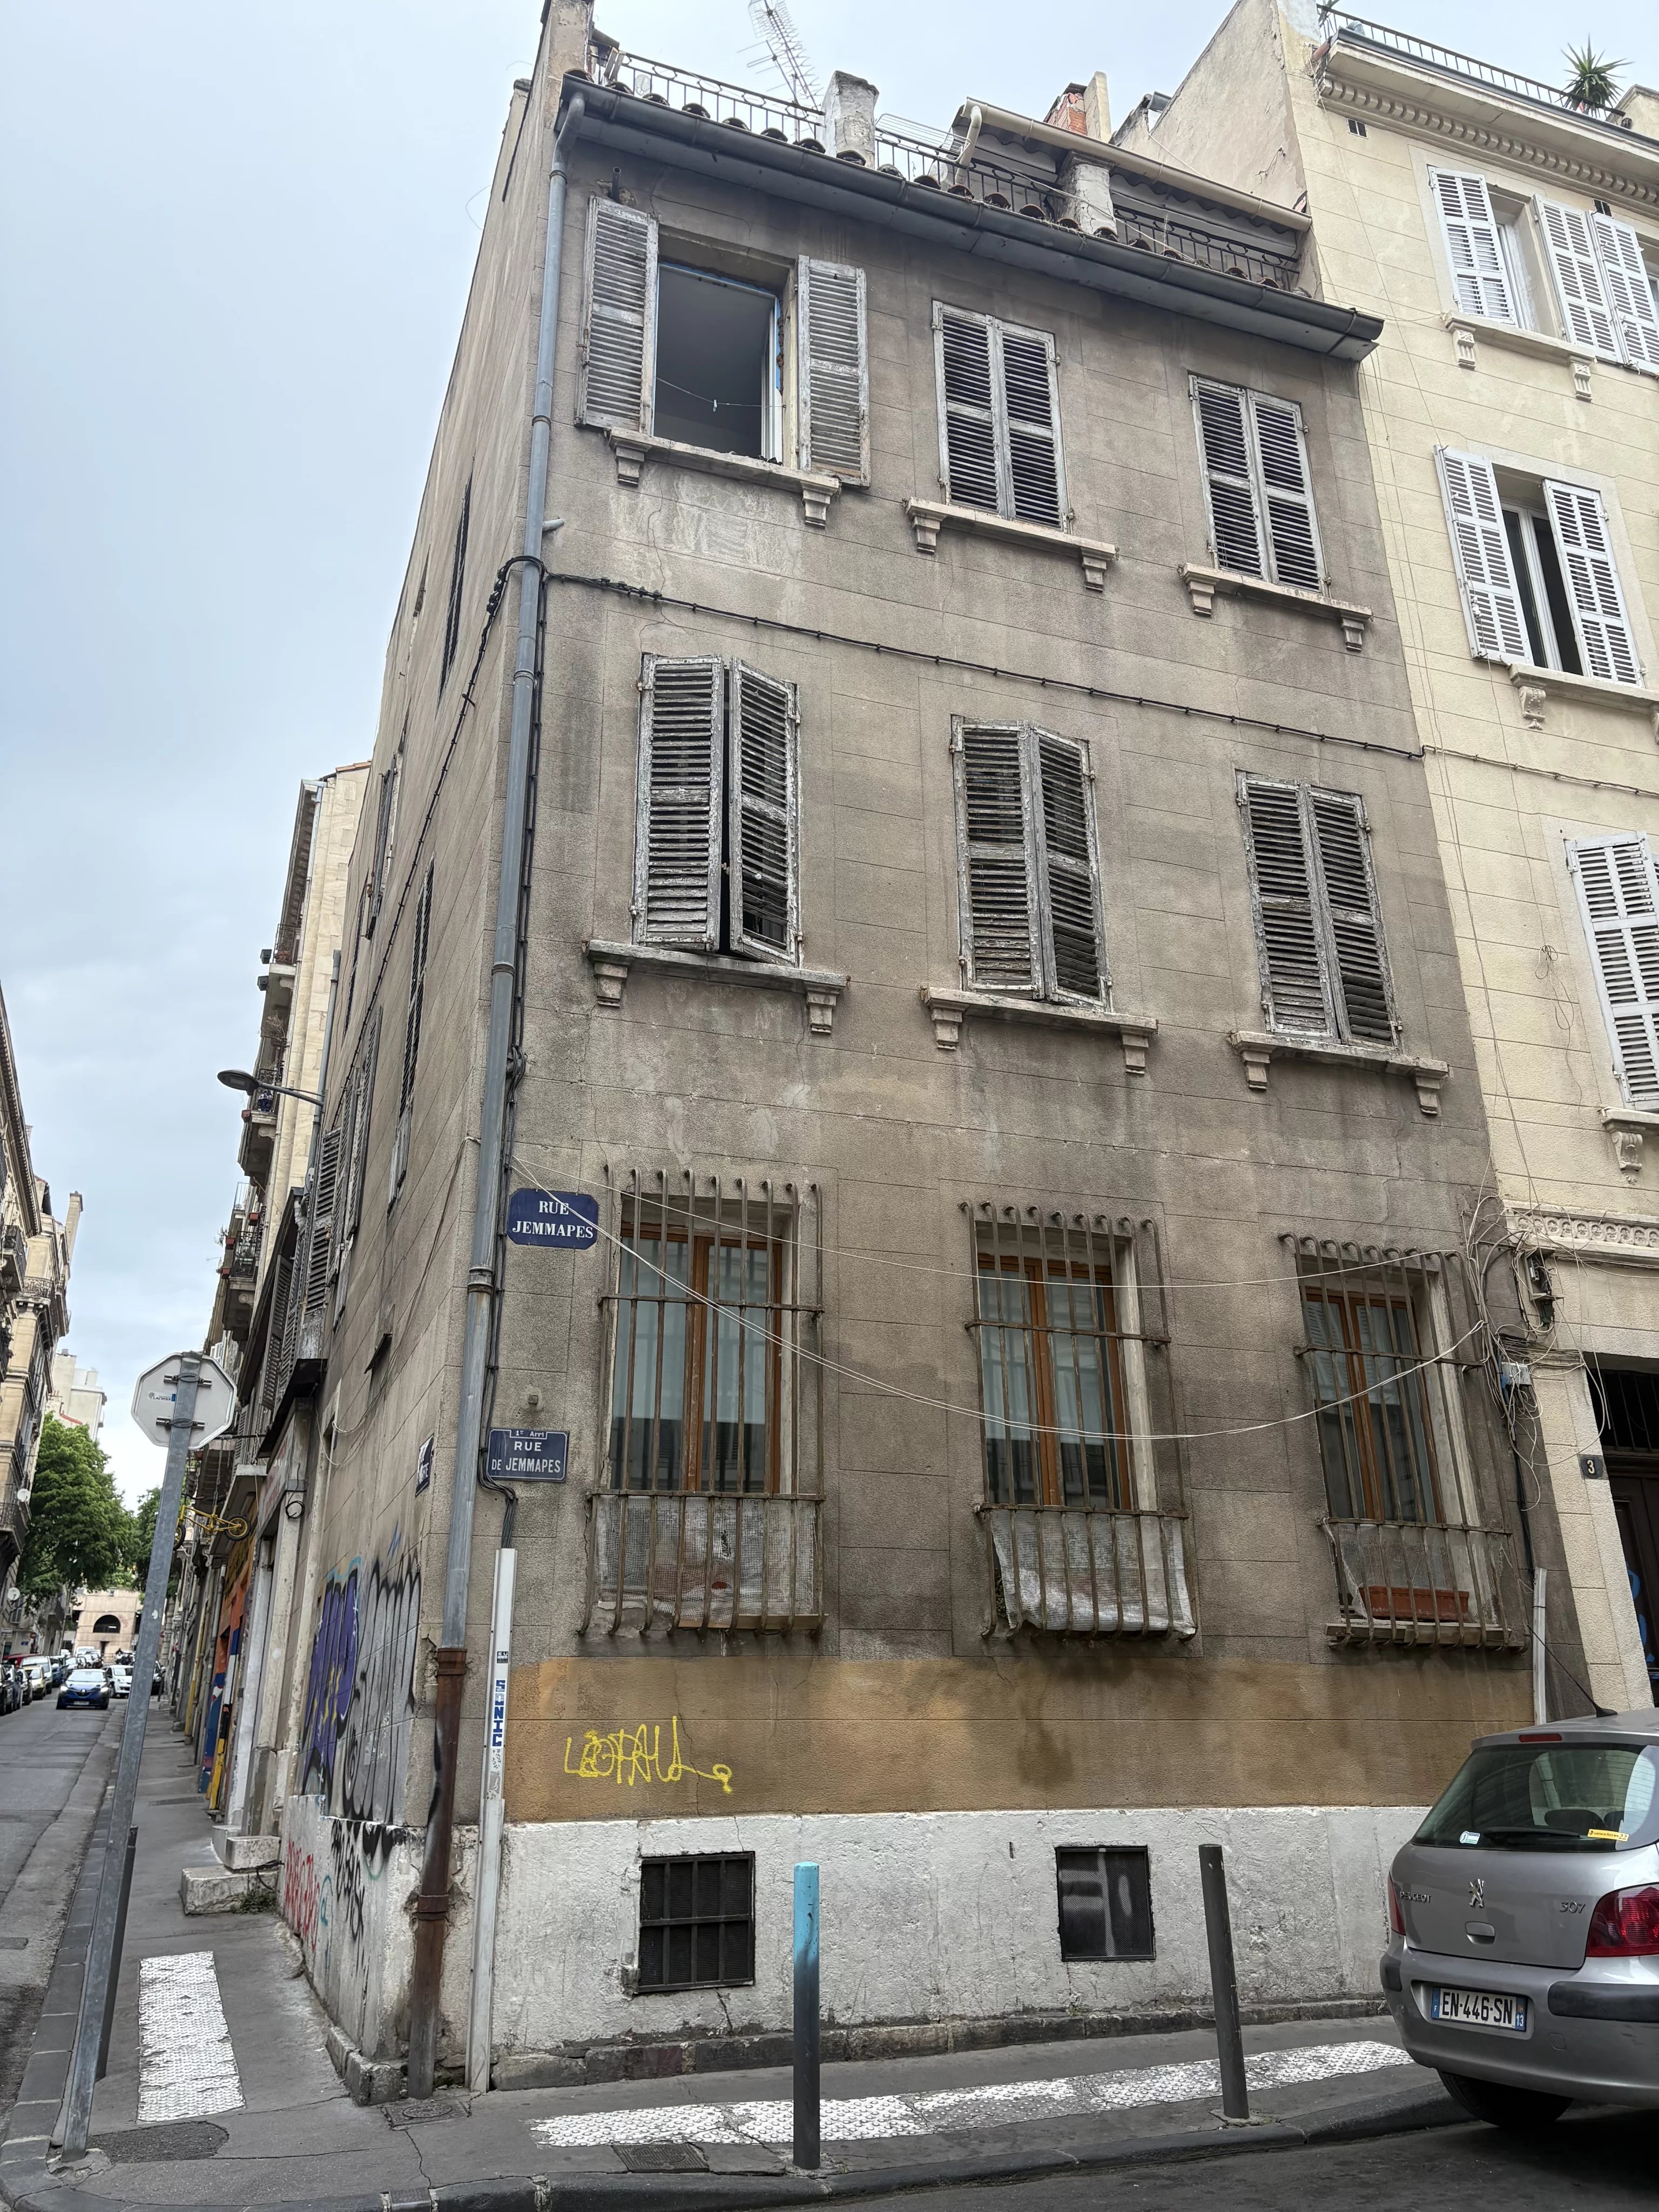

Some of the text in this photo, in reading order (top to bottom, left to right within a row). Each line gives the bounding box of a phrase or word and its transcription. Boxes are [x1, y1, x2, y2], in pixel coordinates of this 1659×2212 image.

[538, 1201, 569, 1215] RUE
[512, 1220, 594, 1239] JEMMAPES
[514, 1441, 542, 1452] RUE
[491, 1458, 561, 1473] DE JEMMAPES
[1587, 1460, 1595, 1474] 3
[1400, 1891, 1431, 1903] PEUGEOT
[1559, 1901, 1586, 1914] 307
[1516, 2014, 1524, 2027] 13
